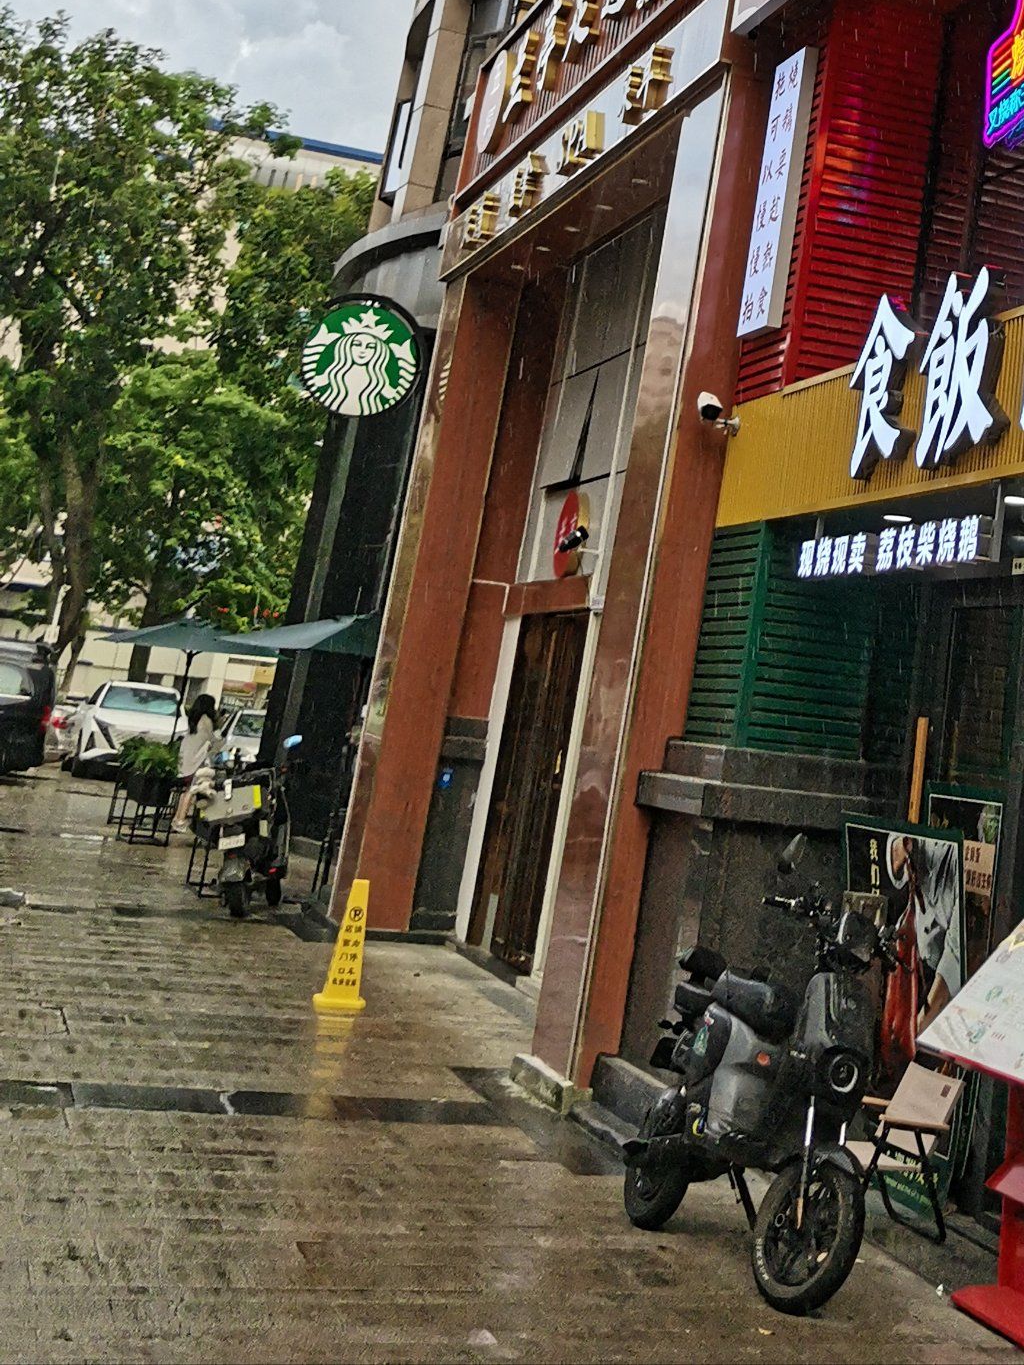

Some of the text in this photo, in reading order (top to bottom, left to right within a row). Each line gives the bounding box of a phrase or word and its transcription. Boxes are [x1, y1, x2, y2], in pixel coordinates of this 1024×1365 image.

[850, 266, 994, 479] 食飯
[797, 514, 980, 578] 现烧现卖 荔枝柴烧鹅
